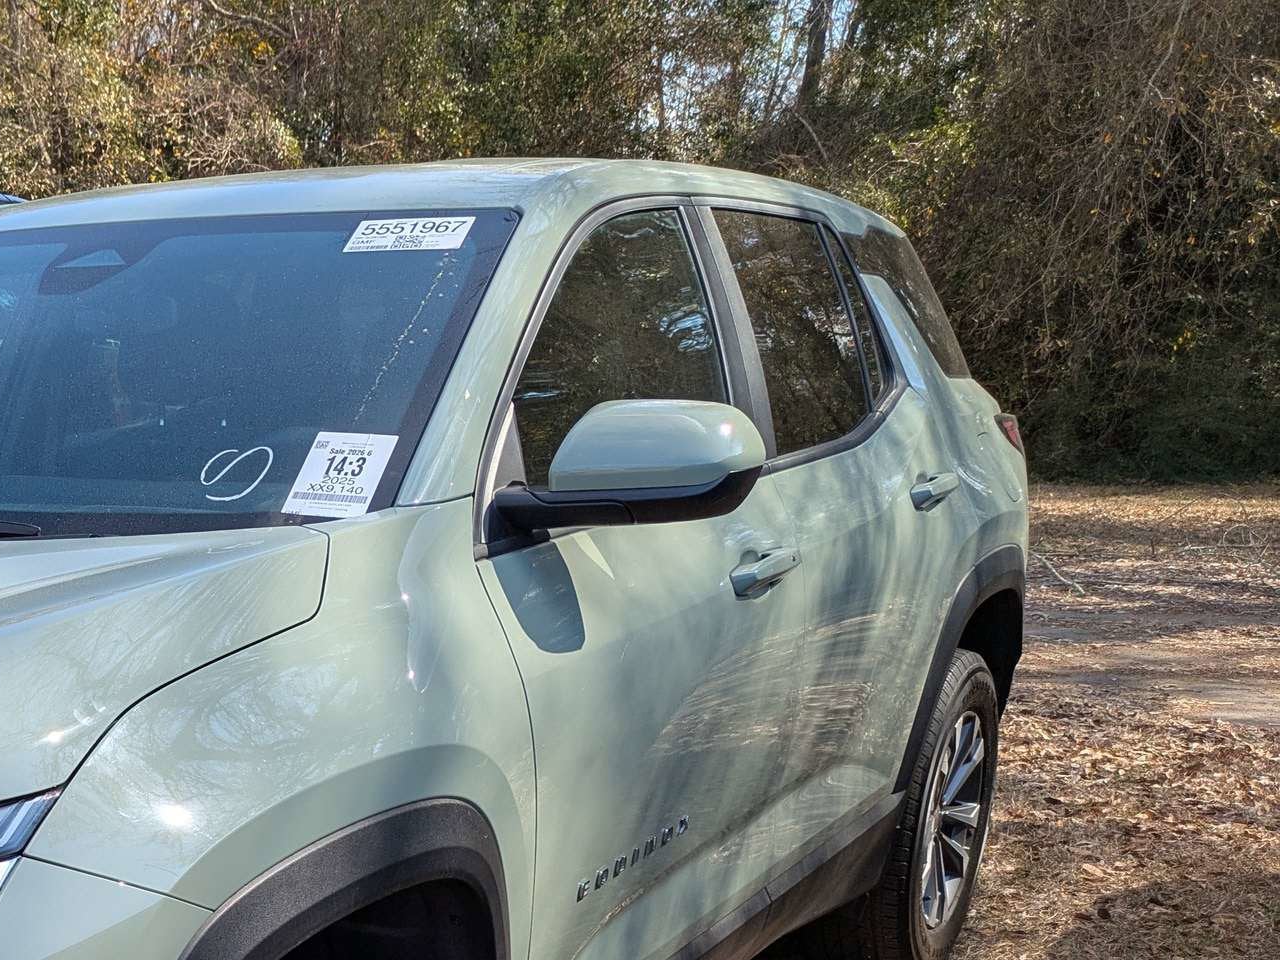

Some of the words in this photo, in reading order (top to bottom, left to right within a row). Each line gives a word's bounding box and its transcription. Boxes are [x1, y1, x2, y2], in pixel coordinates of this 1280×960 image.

[361, 220, 467, 236] 5551967
[329, 447, 346, 455] Sale
[323, 455, 367, 477] 14:3
[321, 475, 357, 486] 2025
